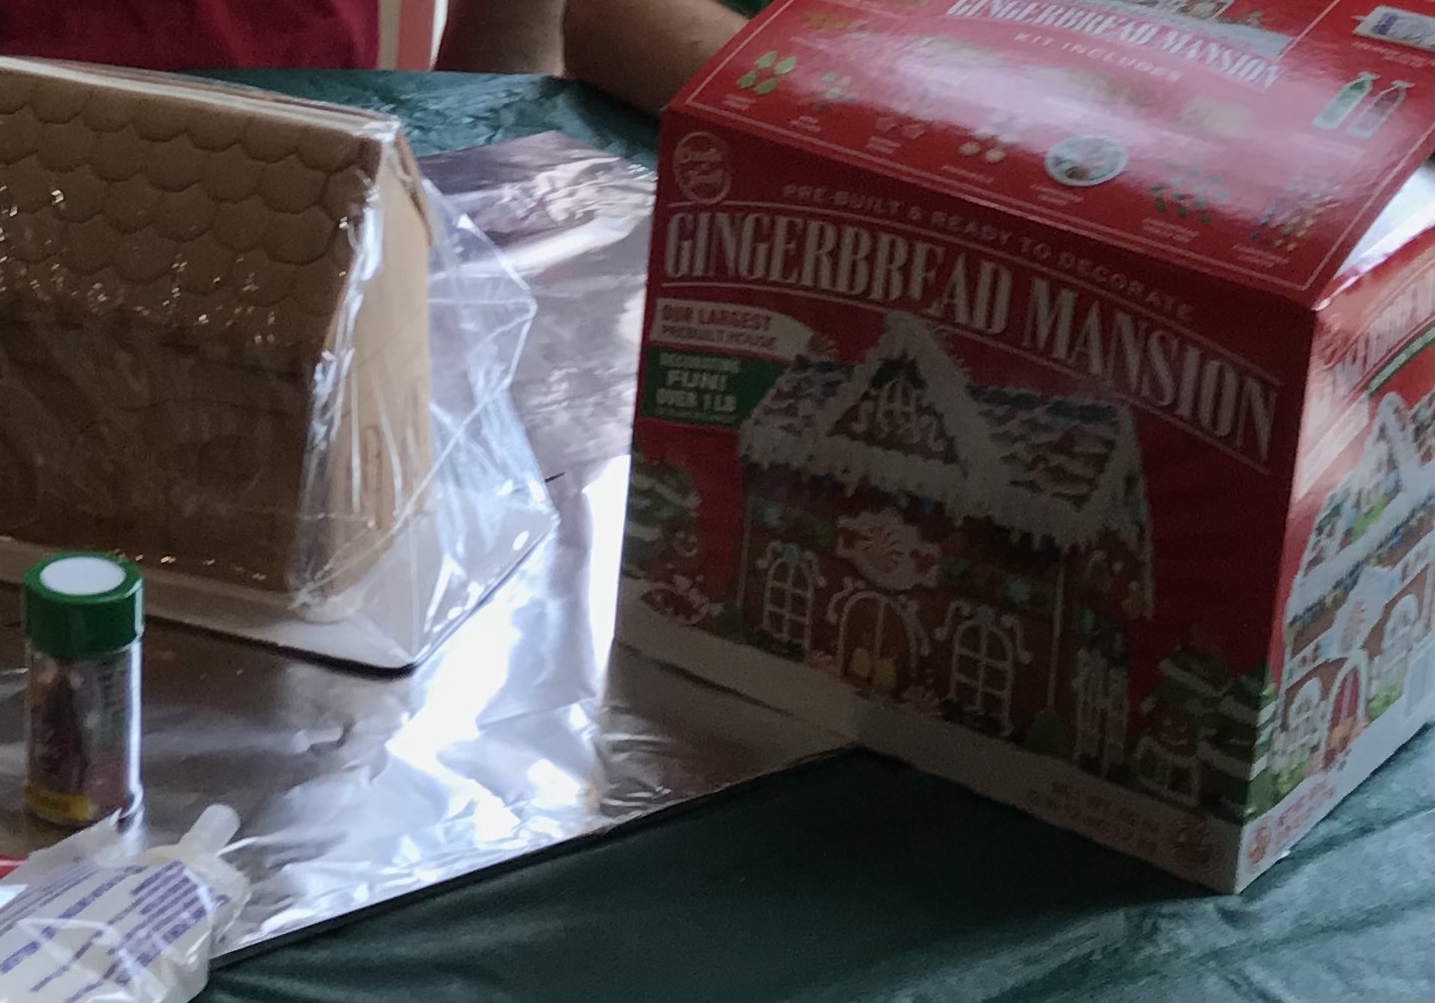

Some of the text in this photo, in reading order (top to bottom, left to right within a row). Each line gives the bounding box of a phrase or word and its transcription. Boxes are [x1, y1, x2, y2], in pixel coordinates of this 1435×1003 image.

[1158, 29, 1284, 90] MANSION
[931, 210, 1012, 246] READY
[1017, 236, 1052, 262] TO
[1058, 252, 1195, 323] DECORATE
[664, 212, 1014, 338] GINGERBREAD
[1023, 278, 1279, 464] MANSION
